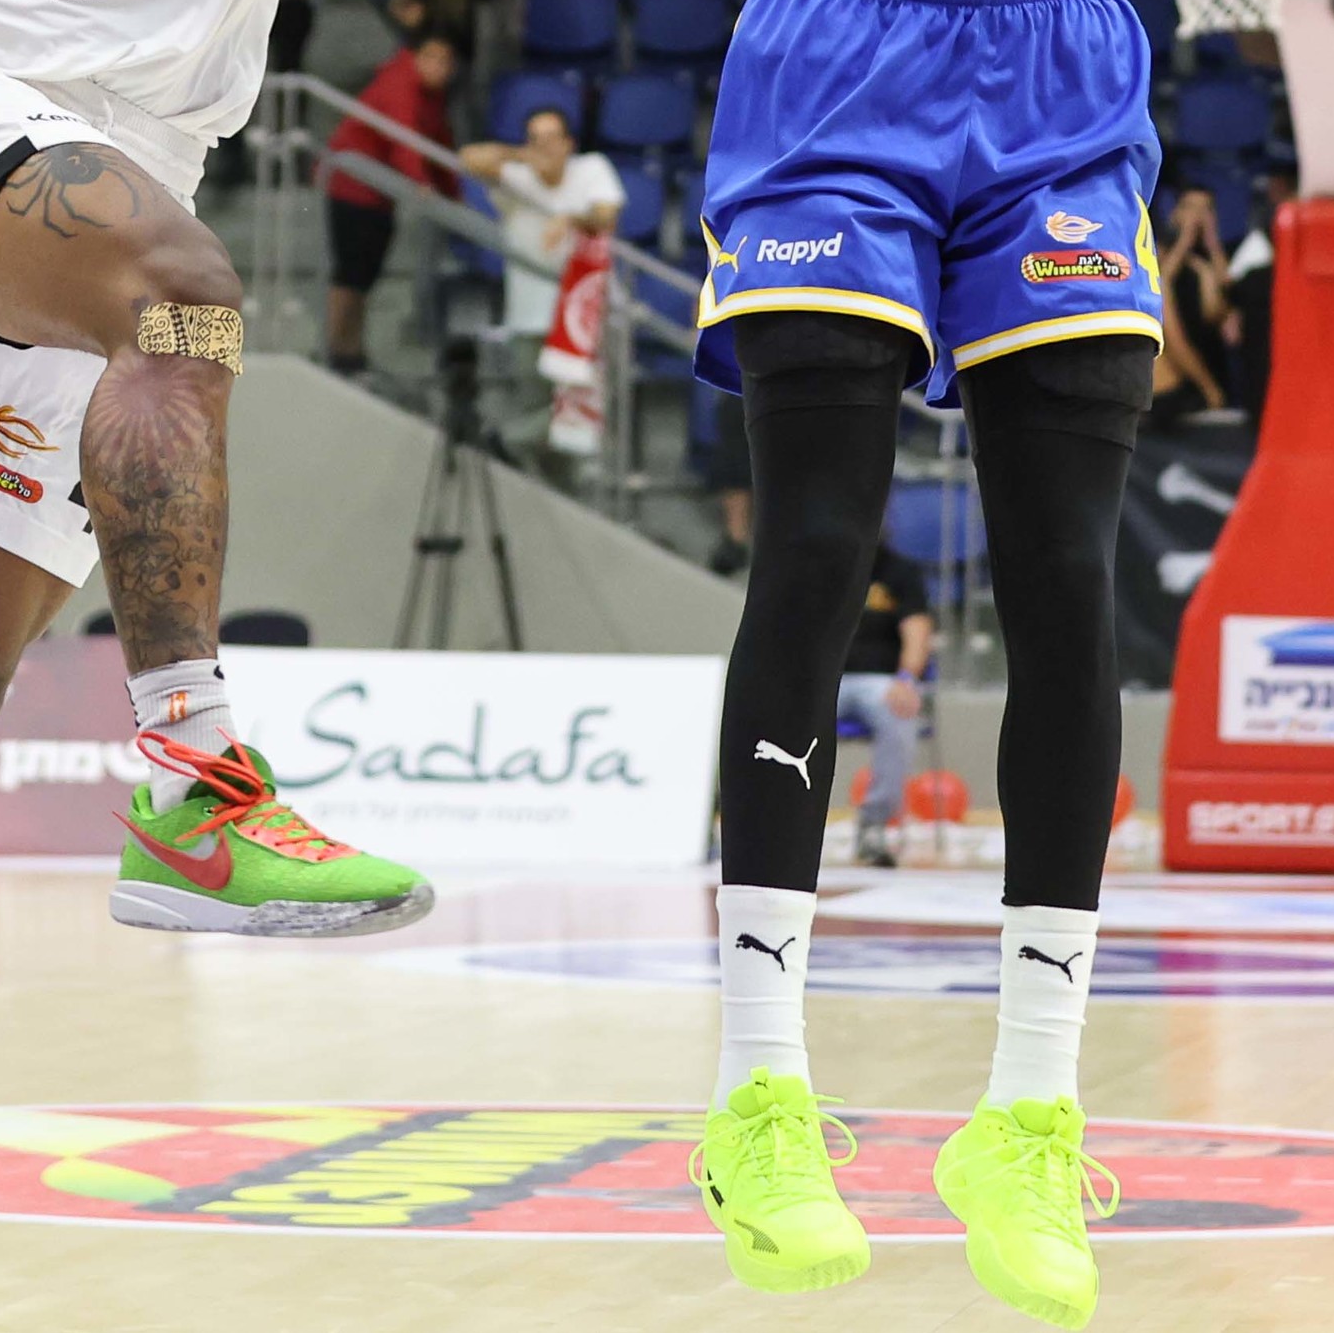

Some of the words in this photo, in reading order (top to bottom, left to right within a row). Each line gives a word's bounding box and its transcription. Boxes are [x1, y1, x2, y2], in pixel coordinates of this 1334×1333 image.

[756, 233, 843, 265] Rapyd
[1034, 260, 1103, 277] Winner
[1104, 262, 1119, 275] סל
[275, 680, 646, 787] Sadafa
